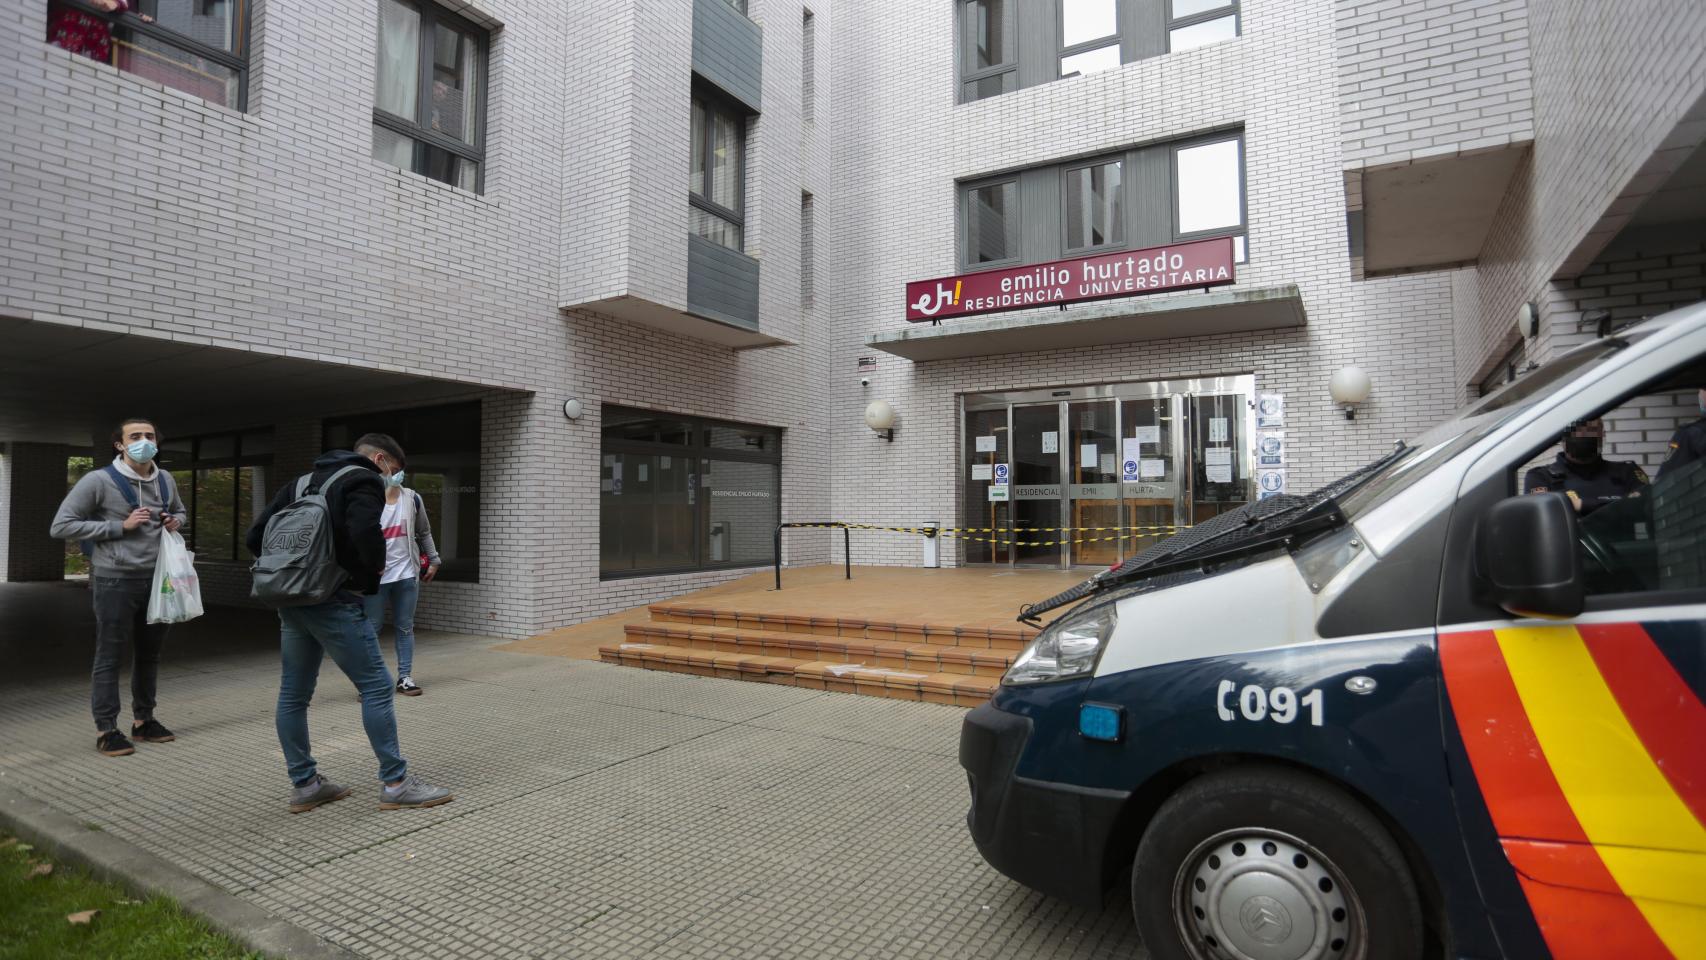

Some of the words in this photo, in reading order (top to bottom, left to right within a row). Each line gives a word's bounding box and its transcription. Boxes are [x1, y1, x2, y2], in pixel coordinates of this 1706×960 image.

[965, 287, 1064, 311] RESIDENCIA
[1079, 266, 1228, 296] UNIVERSITARIA
[1001, 268, 1070, 293] emilio
[1083, 251, 1184, 281] hurtado
[911, 280, 962, 316] eh!
[1015, 488, 1060, 496] RESIDENCIAL
[264, 525, 313, 549] VANS
[1240, 685, 1323, 726] 091
